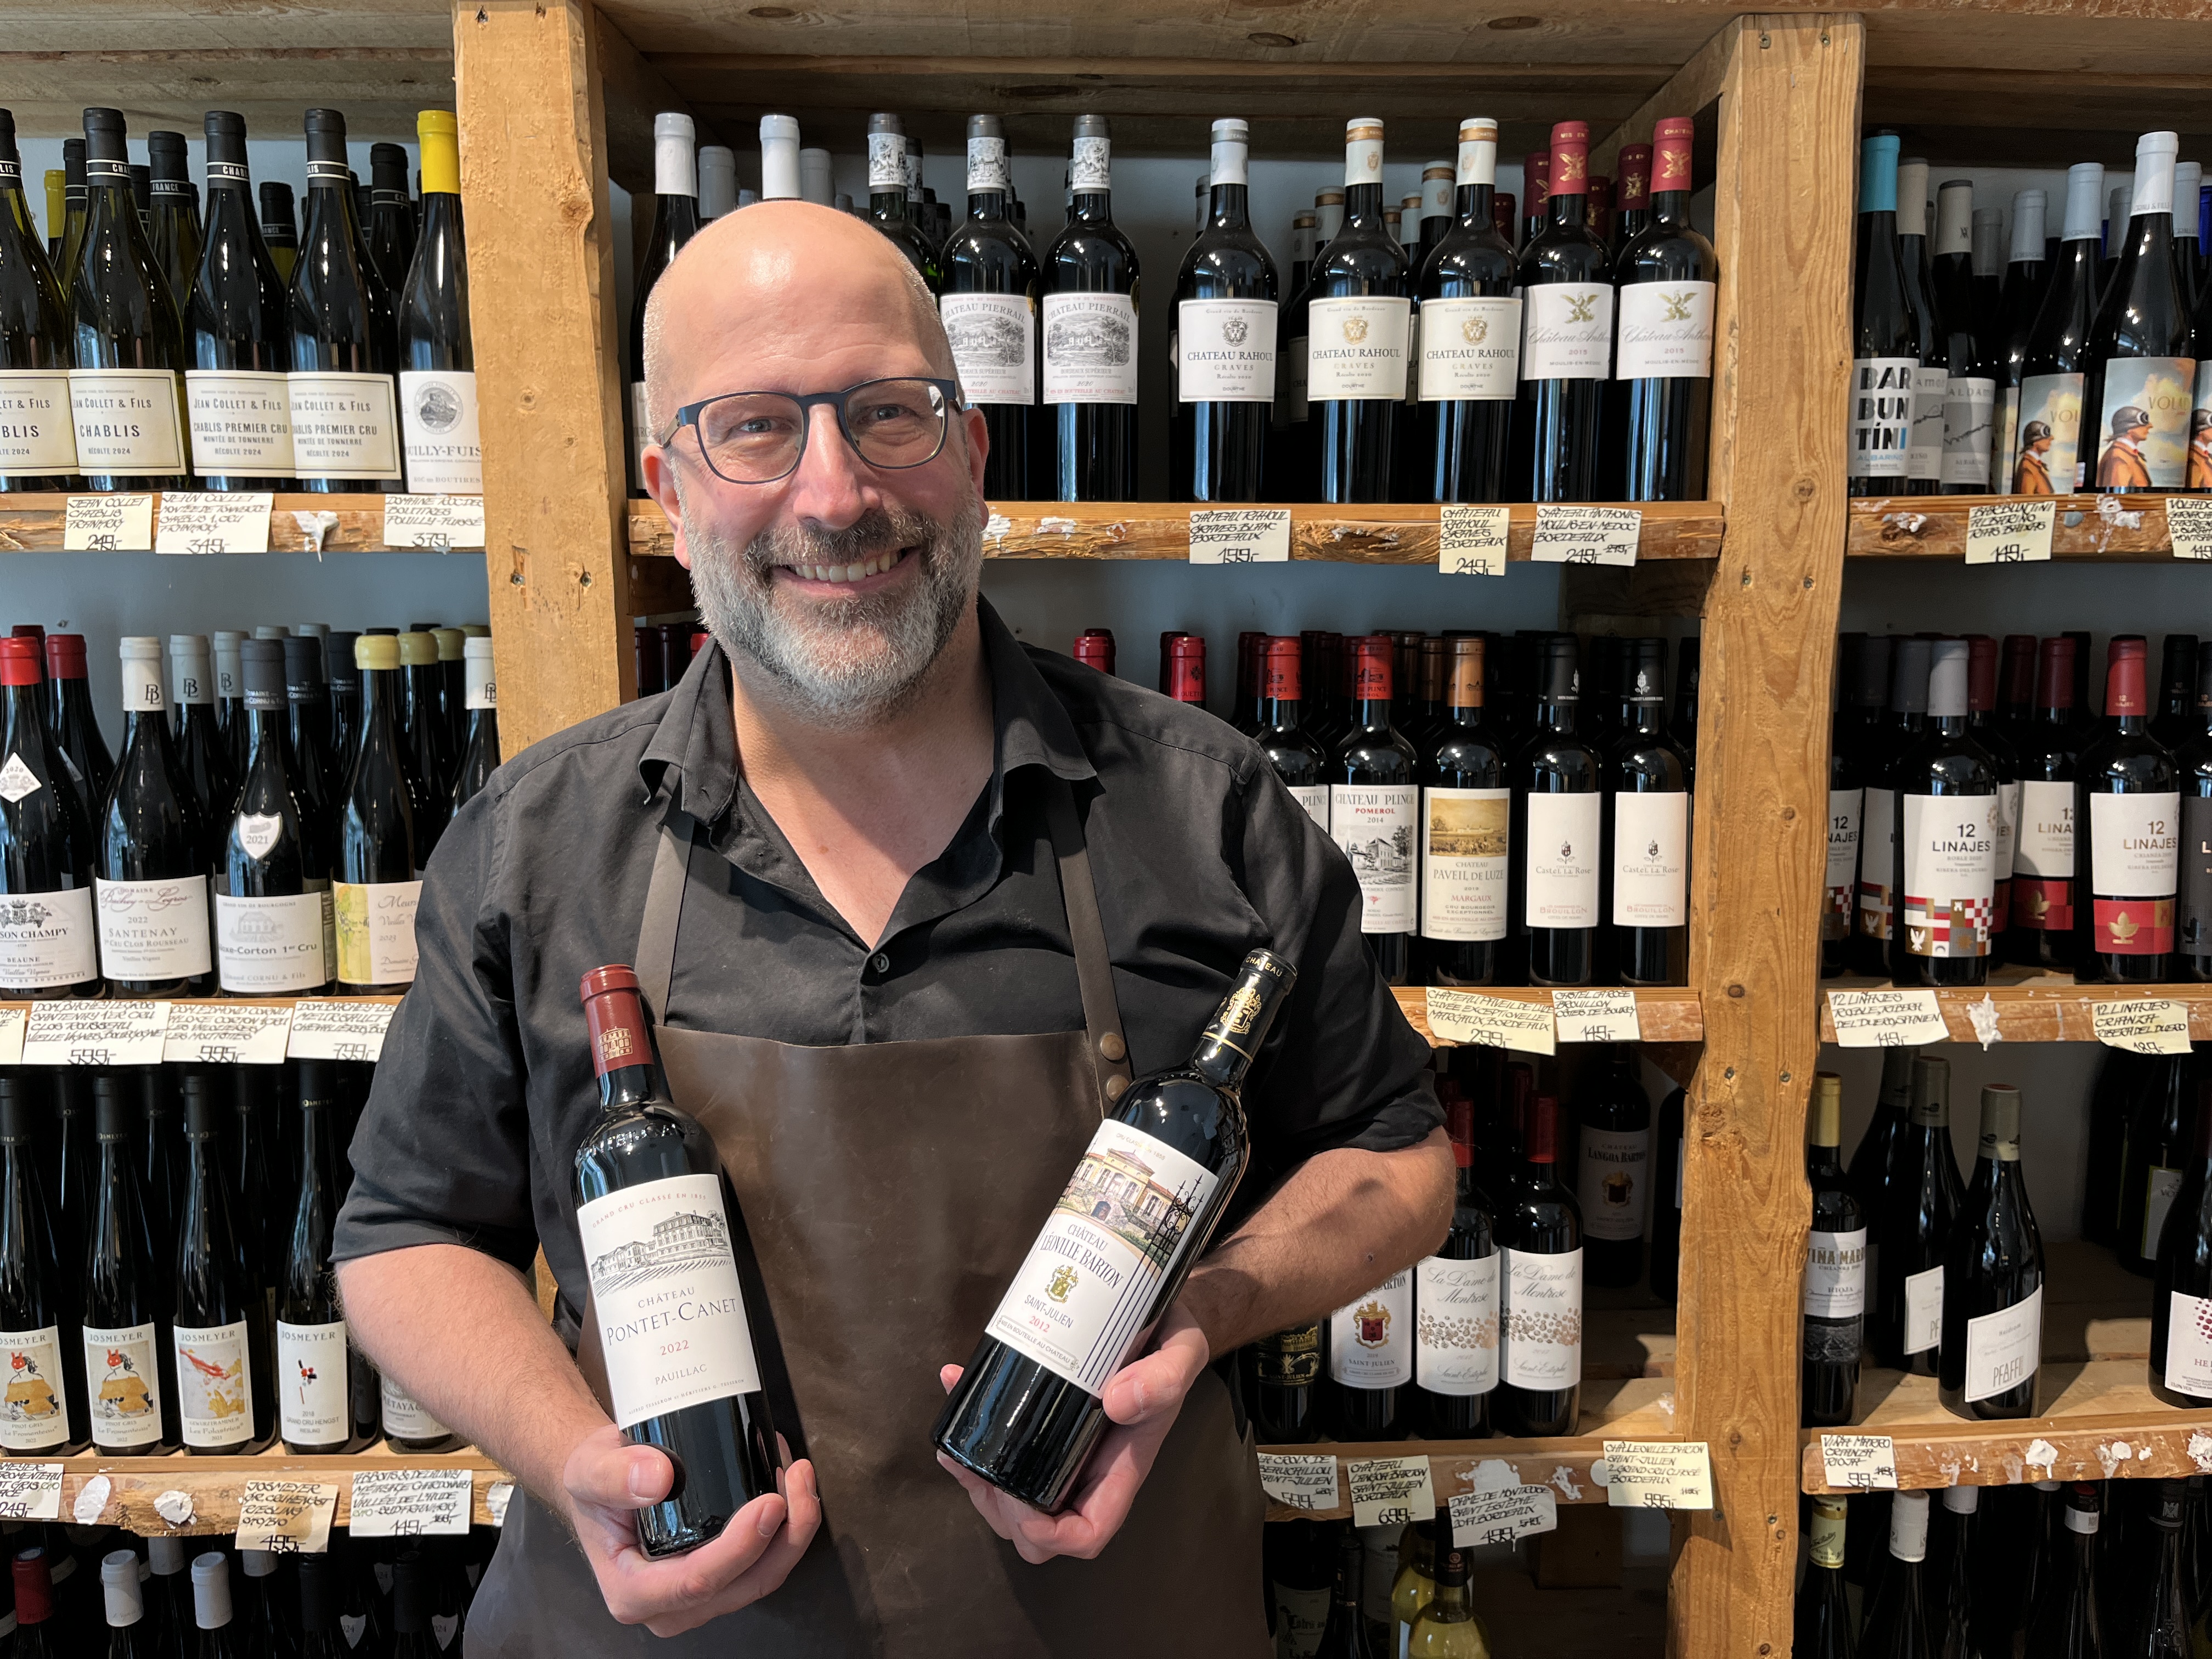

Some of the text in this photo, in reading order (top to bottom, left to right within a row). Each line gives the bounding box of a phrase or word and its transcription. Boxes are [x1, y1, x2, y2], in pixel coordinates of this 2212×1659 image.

[153, 183, 179, 191] FRANCE
[943, 303, 1026, 324] CHATEAU PIERRAIL
[1047, 303, 1131, 323] CHATEAU PIERRAIL
[1188, 352, 1273, 361] CHATEAU RAHOUL
[1313, 349, 1401, 359] CHATEAU RAHOUL
[1426, 349, 1515, 360] CHATEAU RAHOUL
[1860, 366, 1911, 390] BAR
[85, 398, 151, 408] COLLET & FILS
[194, 398, 281, 410] JEAN COLLET & FILS
[302, 400, 371, 412] COLLET FILS
[1858, 397, 1909, 420] BUN
[79, 425, 141, 437] CHABLIS
[194, 422, 287, 433] CHABLIS PREMIER CRU
[315, 425, 377, 436] PREMIER CRU
[104, 496, 151, 506] COLLET
[386, 497, 436, 505] DOMAINE
[1242, 510, 1288, 521] RAHOUL
[1190, 523, 1277, 537] GRAVES BLANC
[1442, 520, 1496, 529] RAHOUL
[1190, 532, 1263, 544] BORDEAUX
[1441, 529, 1491, 543] GRAVES
[1534, 533, 1610, 543] BORDEAUX
[1441, 537, 1506, 549] BORDEAUX
[1335, 793, 1414, 805] CHATEAU PLINCE
[1833, 816, 1848, 829] 12
[2147, 821, 2164, 835] 12
[1957, 824, 1976, 837] 12
[246, 835, 269, 844] 2021
[2123, 837, 2177, 850] LINAJES
[1932, 840, 1991, 852] LINAJES
[1433, 869, 1504, 881] PAVEIL DE LUZE
[1540, 906, 1587, 915] BROUILLON
[21, 927, 69, 938] CHAMPY
[109, 928, 177, 938] SANTENAY
[146, 938, 189, 947] ROUSSEAU
[298, 943, 318, 952] Cru
[1832, 994, 1847, 1005] 12
[2095, 1005, 2109, 1015] 12
[592, 1211, 615, 1228] GRAND
[618, 1203, 635, 1213] CRU
[639, 1193, 672, 1205] CLASSÉ
[1068, 1223, 1109, 1251] CHÂTEAU
[1040, 1231, 1124, 1290] LÉOVILLE BARTON
[1447, 1270, 1486, 1287] Dame
[1524, 1264, 1564, 1282] Dame
[1514, 1282, 1566, 1297] Montrose
[637, 1286, 696, 1308] CHÂTEAU
[1437, 1288, 1488, 1304] Montrose
[1025, 1295, 1074, 1328] SAINT-JULIEN
[607, 1297, 737, 1346] PONTET-CANET
[1029, 1316, 1050, 1333] 2012
[89, 1331, 143, 1342] JOSMEYER
[181, 1330, 235, 1341] JOSMEYER
[281, 1331, 336, 1341] JOSMEYER
[659, 1339, 689, 1356] 2022
[1013, 1327, 1037, 1344] BOUTEILLE
[1037, 1339, 1046, 1348] AU
[1046, 1346, 1070, 1363] CHATEAU
[655, 1364, 707, 1385] PAUILLAC
[646, 1397, 672, 1409] TESSERON
[720, 1378, 745, 1387] TESSERON
[315, 1416, 339, 1424] HENGST
[1609, 1475, 1672, 1484] BORDEAUX
[247, 1481, 321, 1494] JOSMEYER
